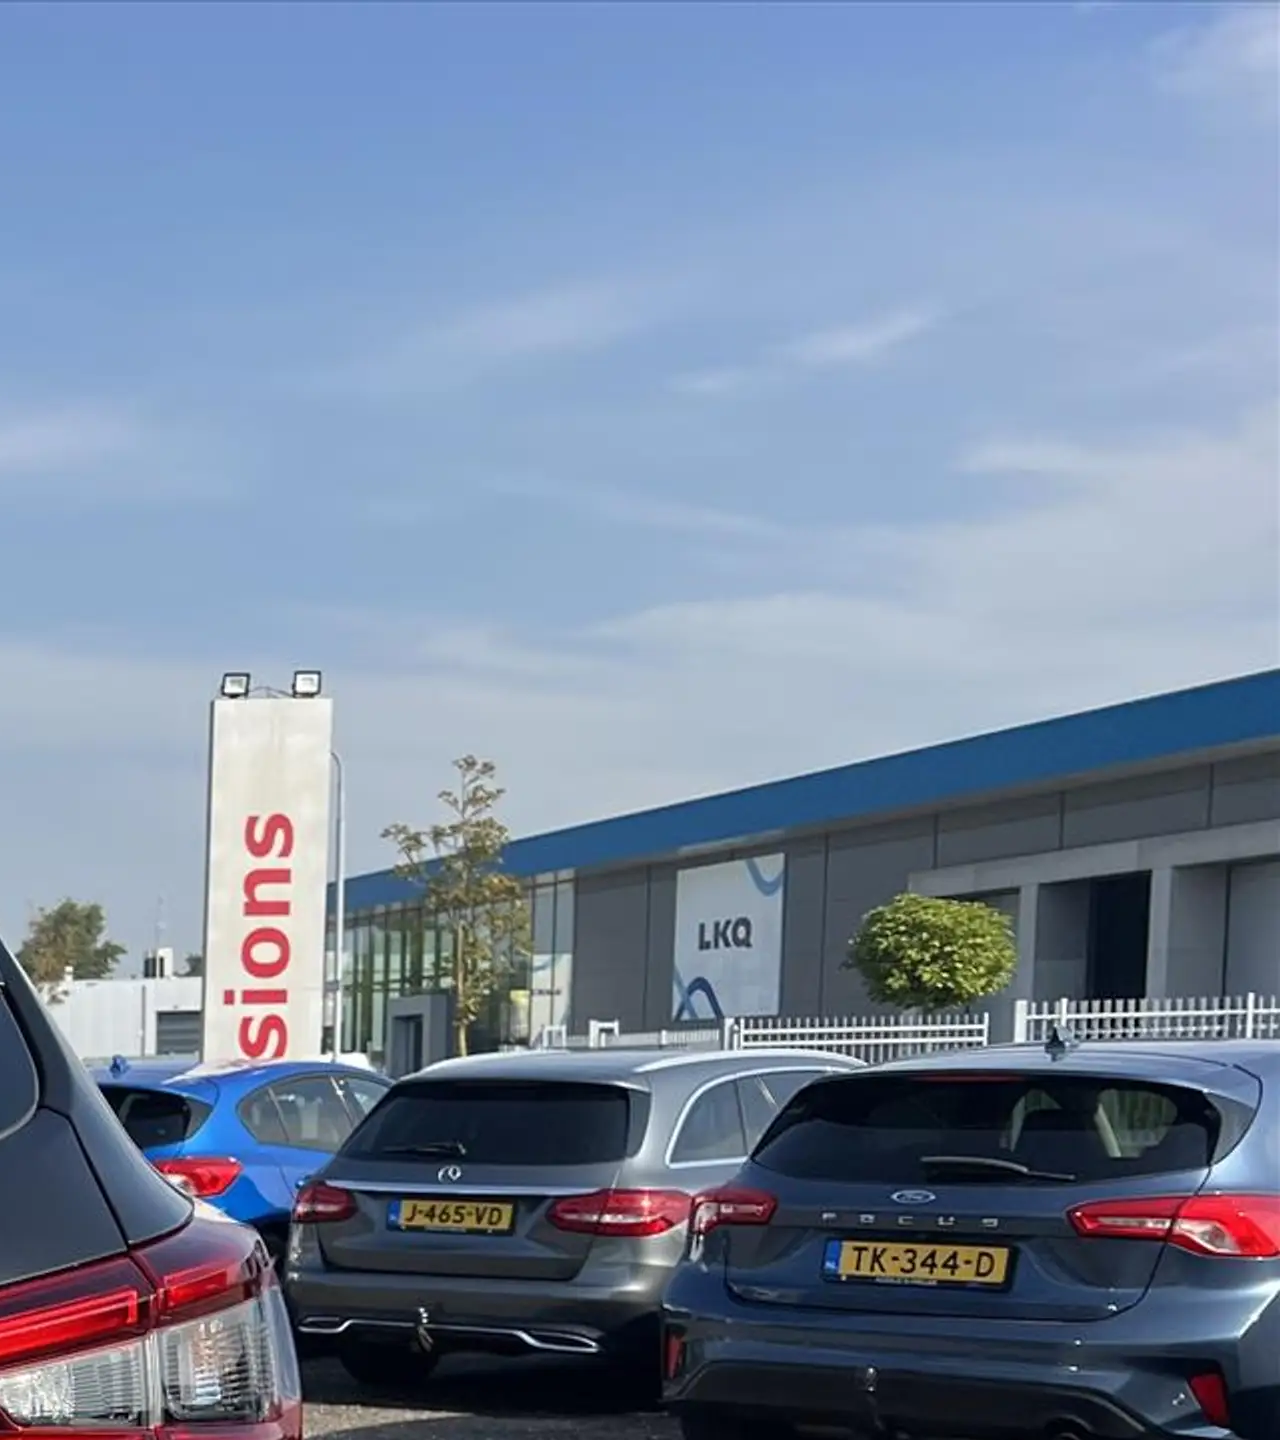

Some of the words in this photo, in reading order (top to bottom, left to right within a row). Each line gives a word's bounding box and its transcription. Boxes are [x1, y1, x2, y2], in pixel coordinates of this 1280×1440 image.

[699, 917, 752, 950] LKQ
[403, 1203, 503, 1226] J-465-VD
[851, 1246, 996, 1278] TK-344-D
